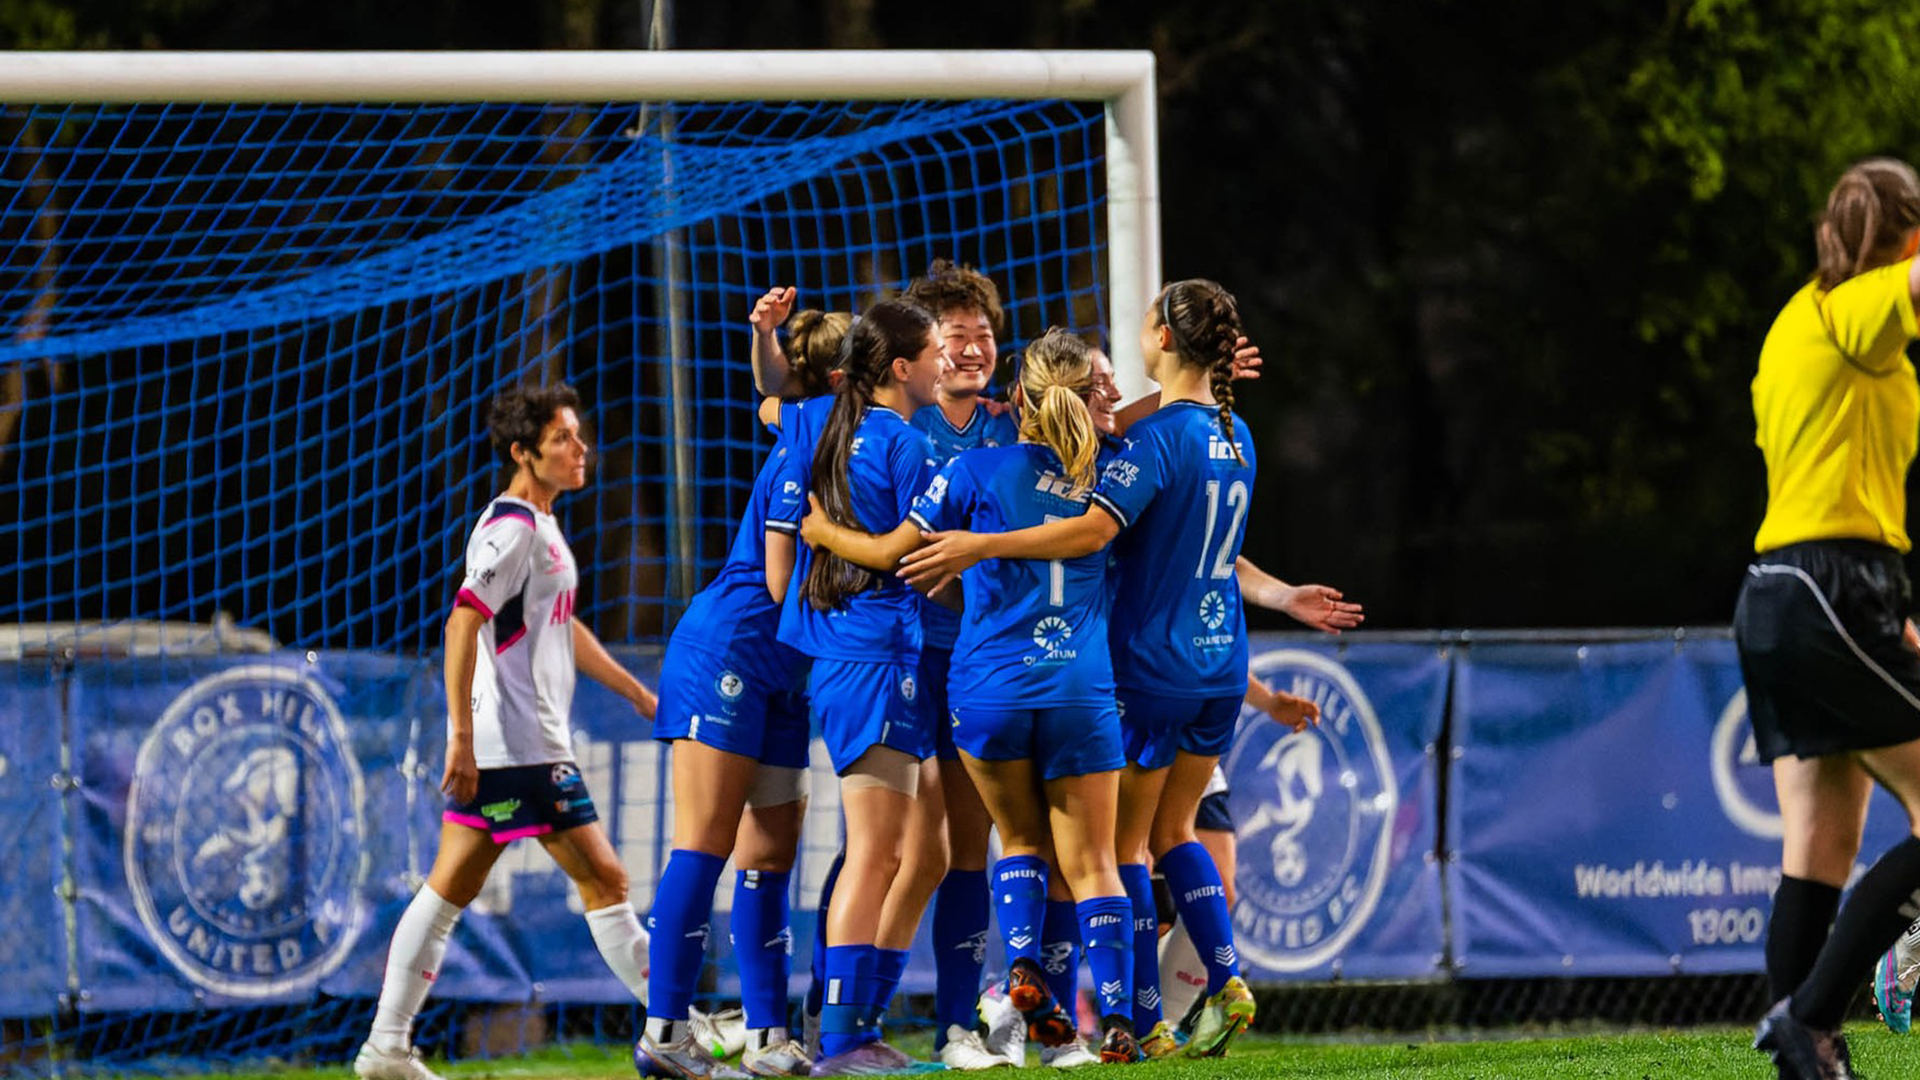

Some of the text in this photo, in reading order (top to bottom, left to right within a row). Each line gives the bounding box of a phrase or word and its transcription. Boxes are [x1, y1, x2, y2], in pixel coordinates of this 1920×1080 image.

[1195, 479, 1249, 580] 12
[172, 692, 243, 758] BOX
[1574, 859, 1726, 898] Worldwide
[169, 904, 301, 974] UNITED
[1234, 899, 1324, 949] NITED
[1687, 906, 1765, 945] 1300
